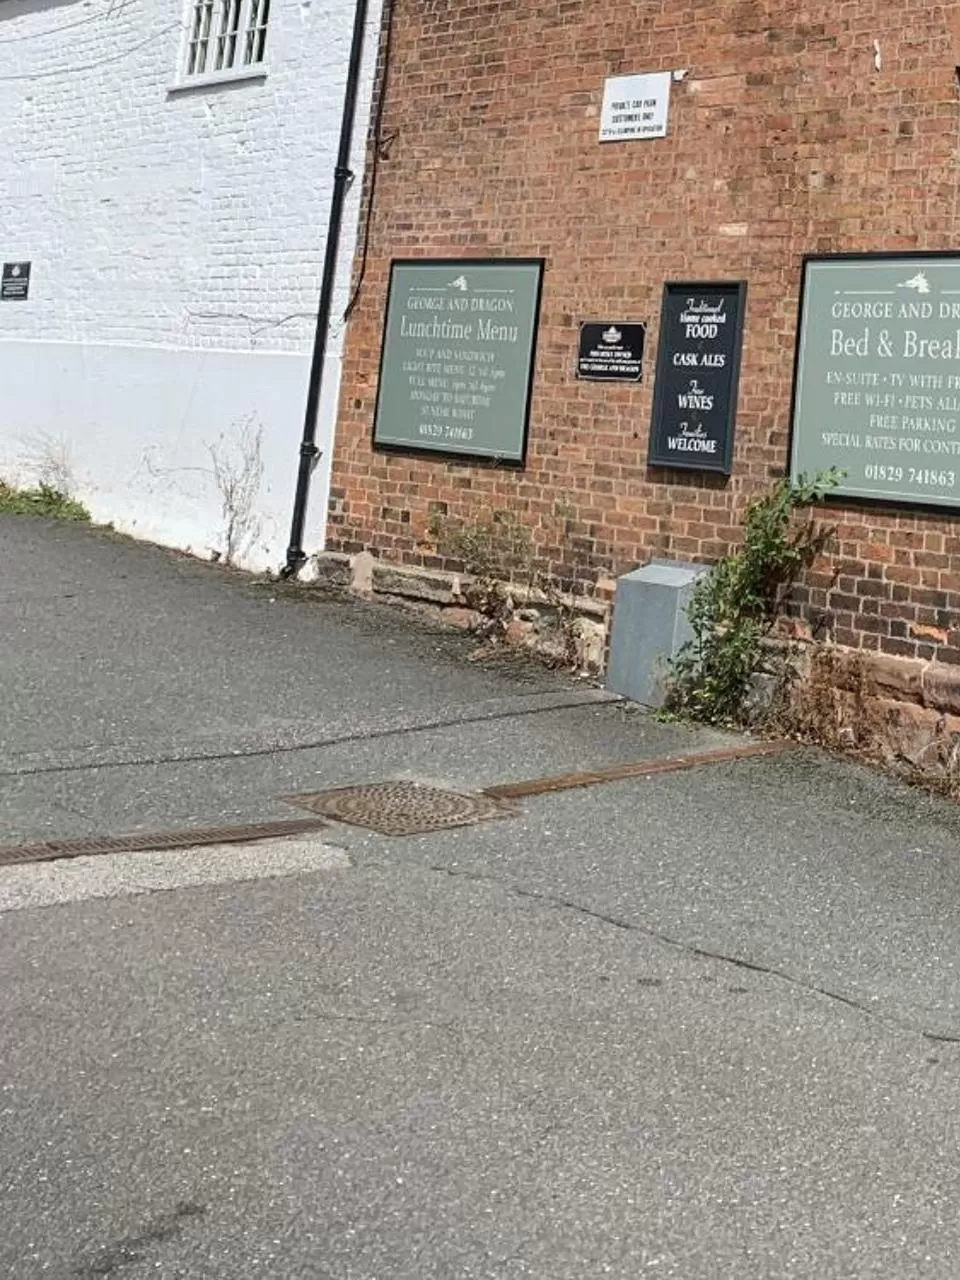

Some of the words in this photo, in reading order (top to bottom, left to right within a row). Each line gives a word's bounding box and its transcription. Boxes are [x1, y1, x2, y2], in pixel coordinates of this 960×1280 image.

[407, 296, 444, 311] GEORGE
[448, 297, 468, 311] AND
[471, 298, 514, 312] DRAGON
[831, 302, 893, 319] GEORGE
[897, 302, 933, 319] AND
[400, 315, 472, 340] Lunchtime
[477, 319, 518, 342] Menu
[685, 324, 717, 339] FOOD
[831, 328, 869, 357] Bed
[877, 330, 894, 357] &
[673, 353, 698, 367] CASK
[700, 354, 725, 368] ALES
[827, 371, 879, 386] EN-SUITE
[890, 372, 904, 387] TV
[909, 374, 943, 389] WITH
[678, 395, 714, 410] WINES
[834, 392, 861, 406] FREE
[865, 392, 895, 408] WI-FI
[904, 395, 933, 410] PETS
[870, 414, 899, 430] FREE
[902, 416, 957, 433] PARKING
[668, 437, 717, 453] WELCOME
[821, 433, 861, 448] SPECIAL
[865, 435, 897, 450] RATES
[899, 437, 921, 451] FOR
[865, 464, 903, 482] 01829
[907, 468, 956, 487] 741863
